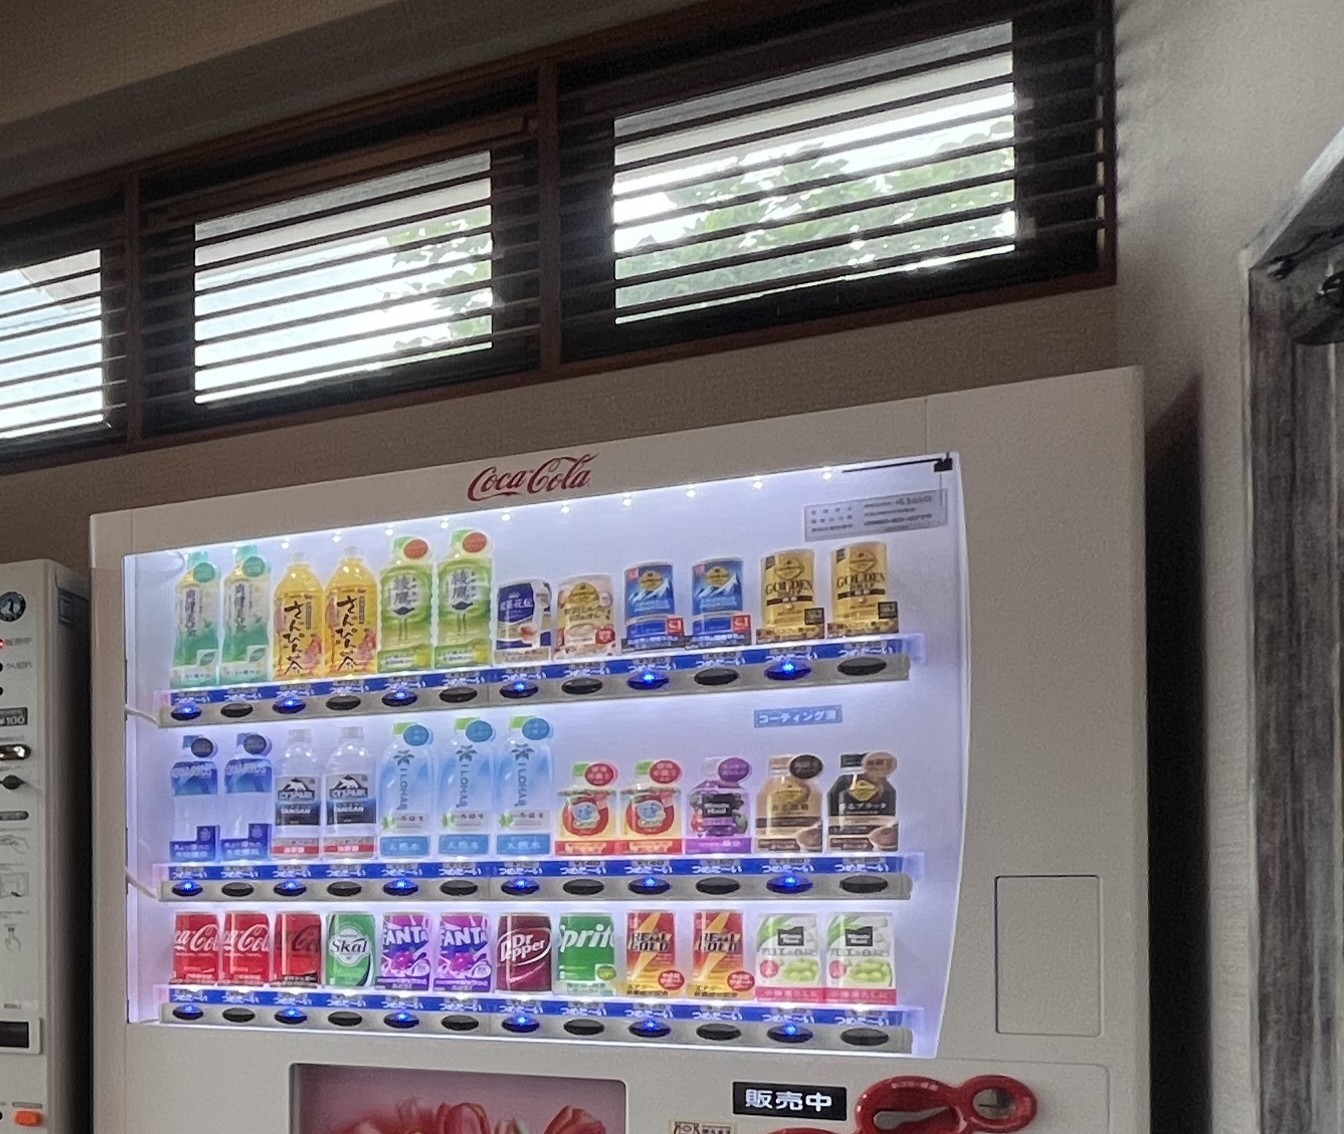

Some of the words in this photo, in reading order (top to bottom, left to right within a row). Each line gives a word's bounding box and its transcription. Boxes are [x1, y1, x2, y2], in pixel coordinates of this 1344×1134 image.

[467, 453, 600, 502] Coca-Cola
[512, 933, 534, 945] Dr
[560, 923, 615, 953] prit
[745, 1088, 832, 1112] 販売中
